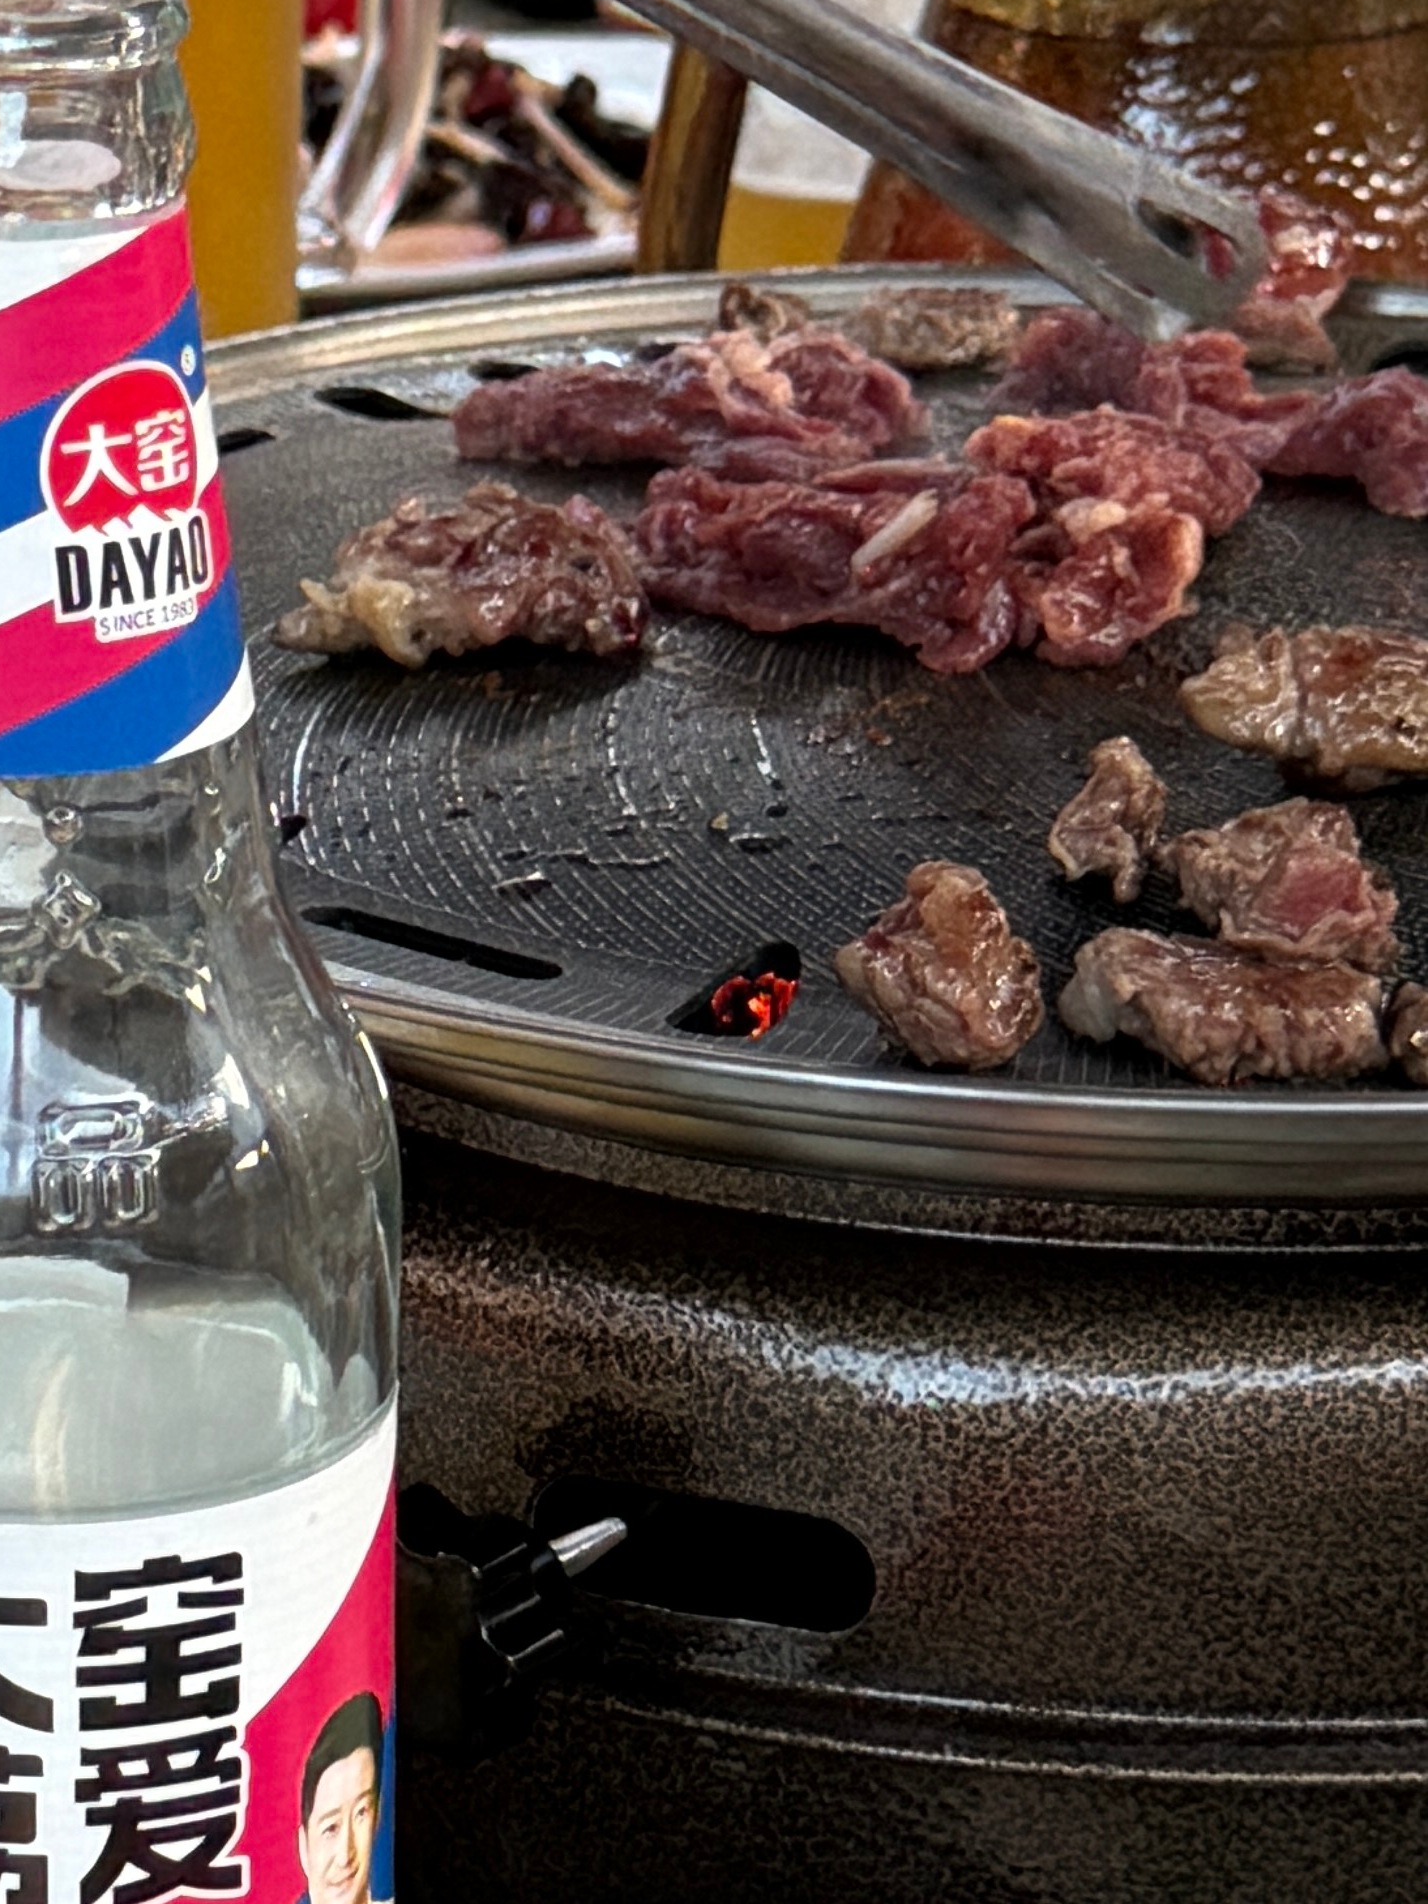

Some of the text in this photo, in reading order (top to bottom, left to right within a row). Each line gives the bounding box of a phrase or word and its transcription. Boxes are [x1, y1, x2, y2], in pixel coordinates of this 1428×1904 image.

[60, 408, 190, 507] 大窑
[55, 515, 210, 614] DAYAO
[99, 598, 194, 636] SINCE 1983
